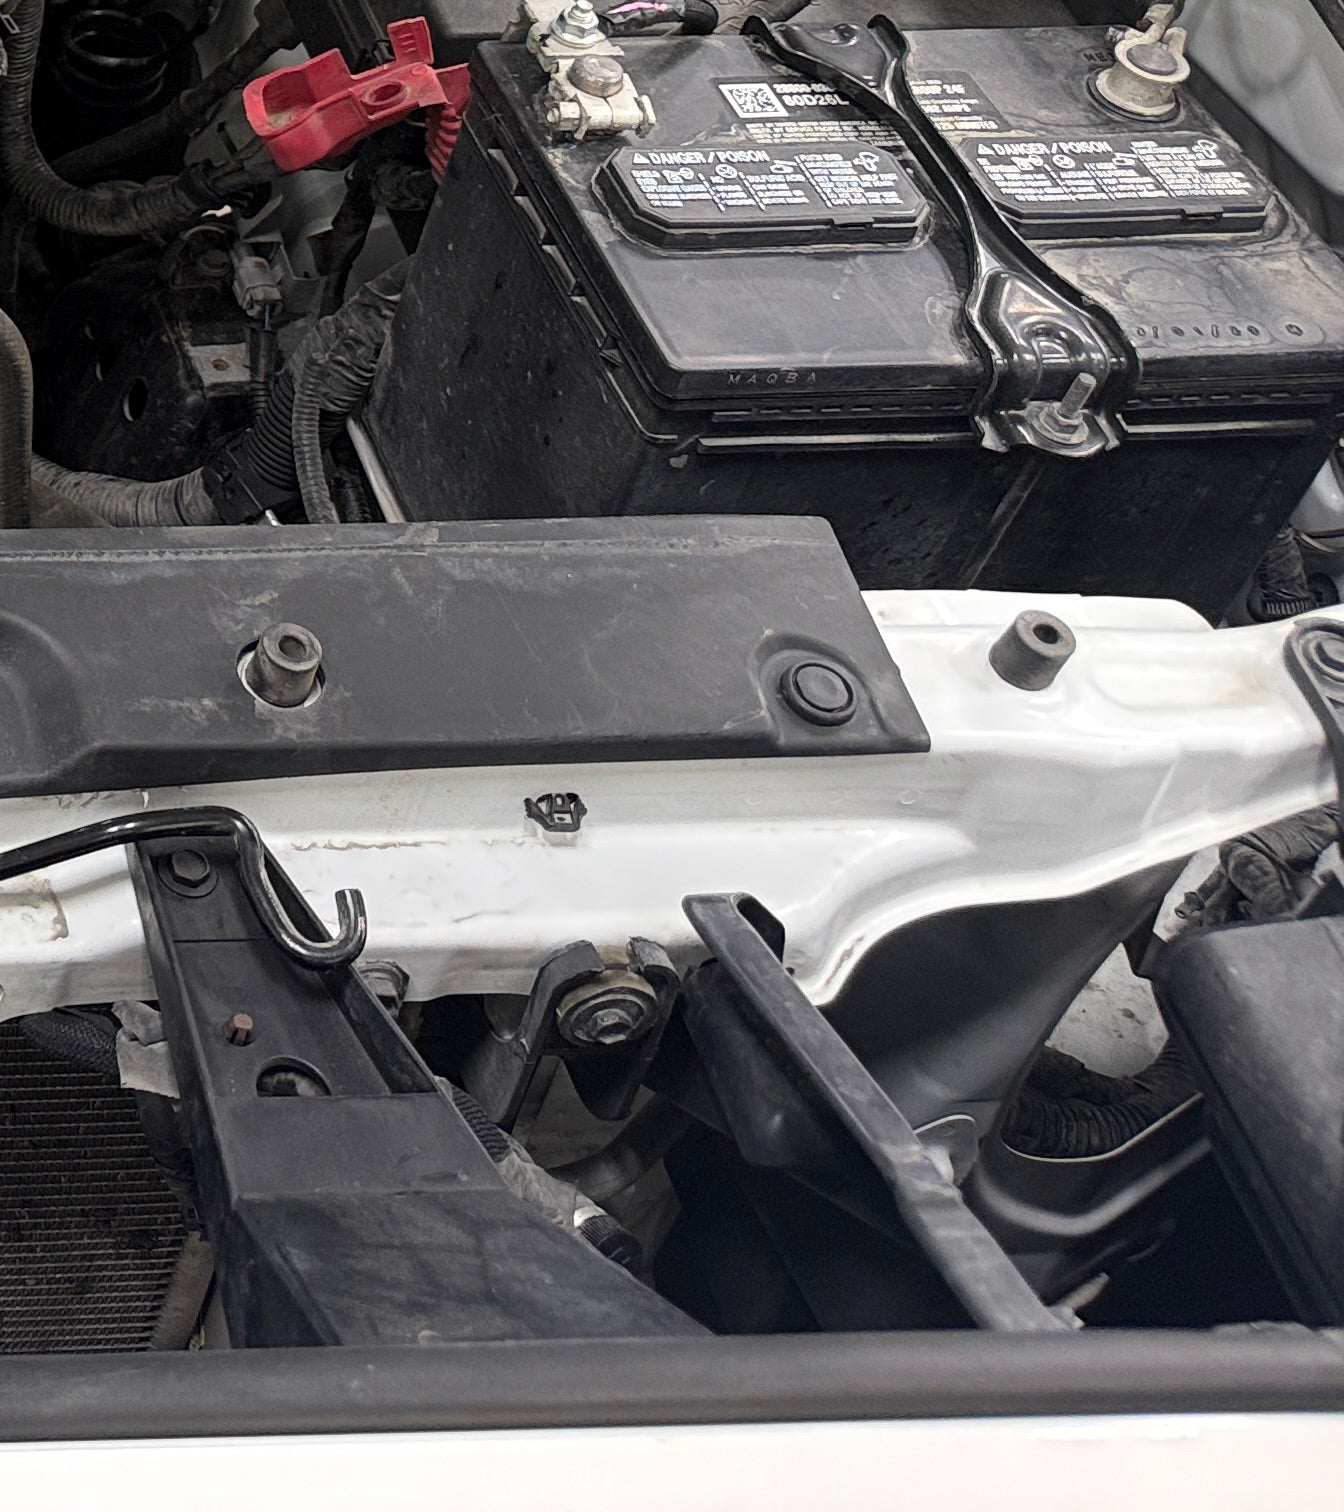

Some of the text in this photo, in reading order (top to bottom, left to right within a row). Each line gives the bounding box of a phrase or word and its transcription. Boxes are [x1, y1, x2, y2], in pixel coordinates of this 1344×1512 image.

[992, 143, 1050, 156] DANGER
[1060, 141, 1112, 154] POISON
[648, 151, 707, 165] DANGER
[716, 150, 771, 163] POISON
